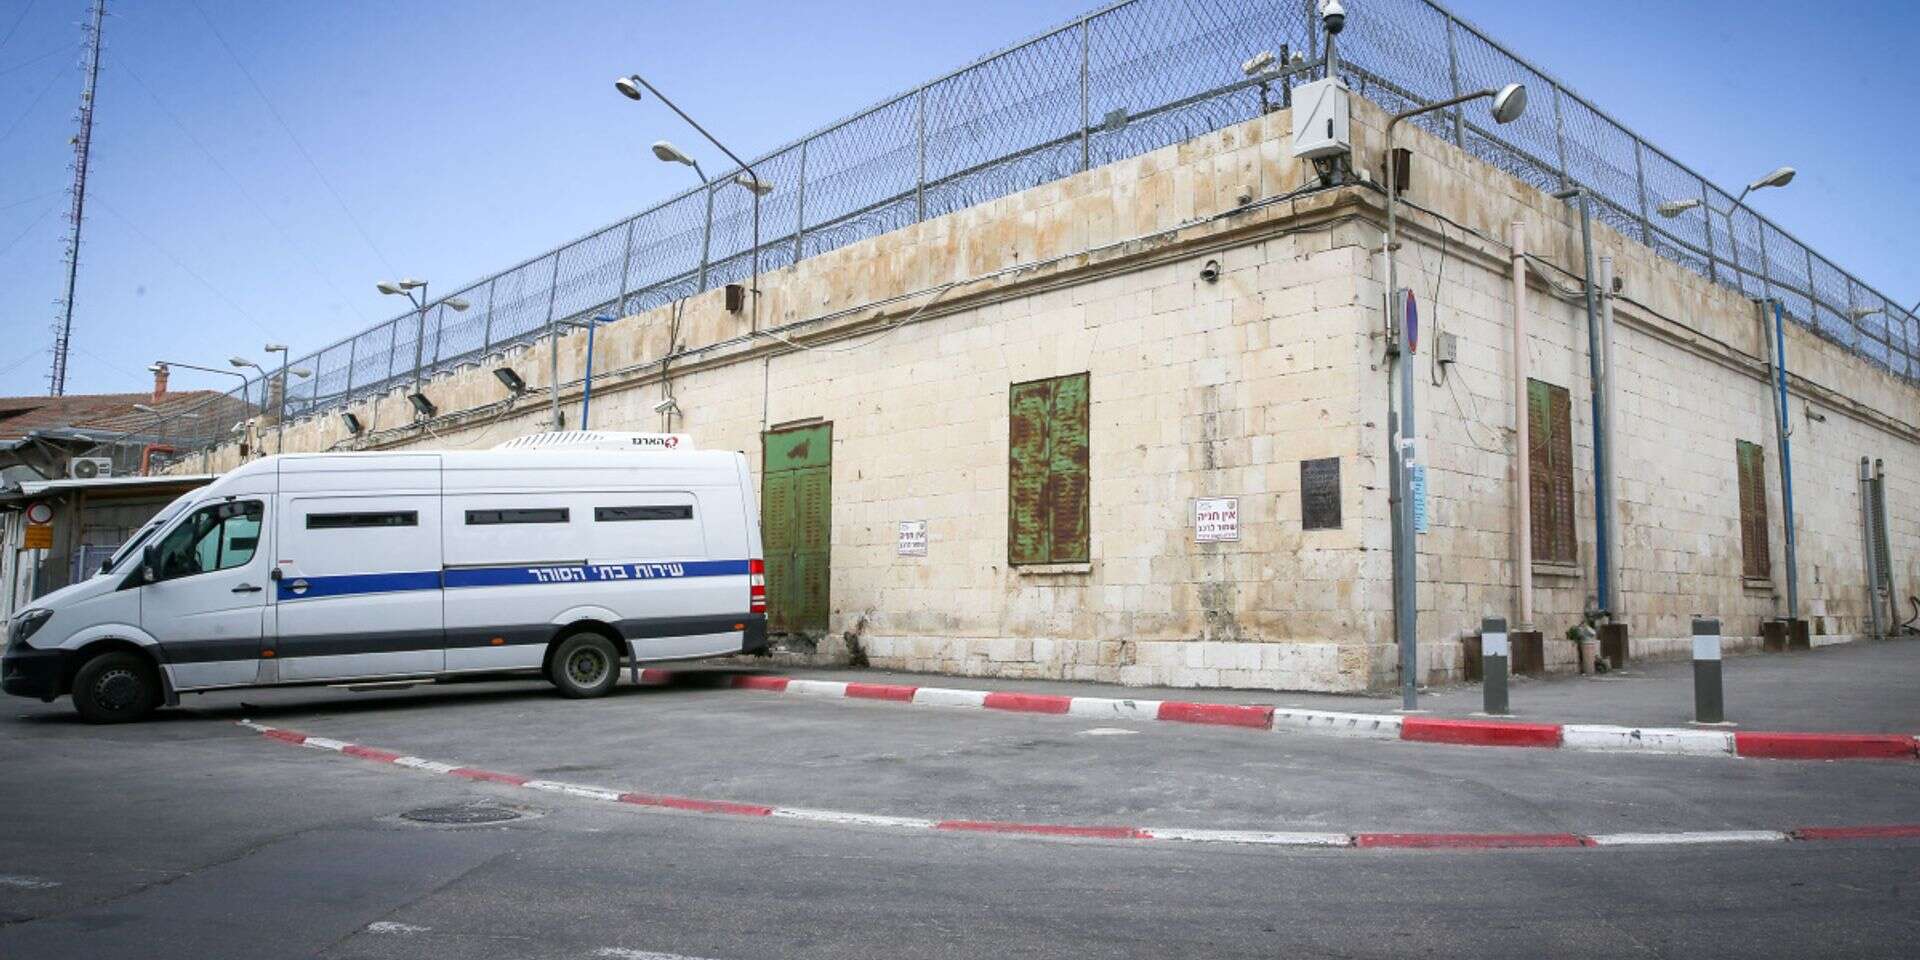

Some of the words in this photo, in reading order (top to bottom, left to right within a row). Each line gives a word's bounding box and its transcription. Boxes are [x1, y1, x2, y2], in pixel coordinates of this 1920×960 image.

[1197, 511, 1220, 521] חניה
[1222, 511, 1235, 521] אין
[528, 567, 586, 582] הסוהר
[592, 566, 628, 580] בתי
[635, 563, 684, 578] שירות
